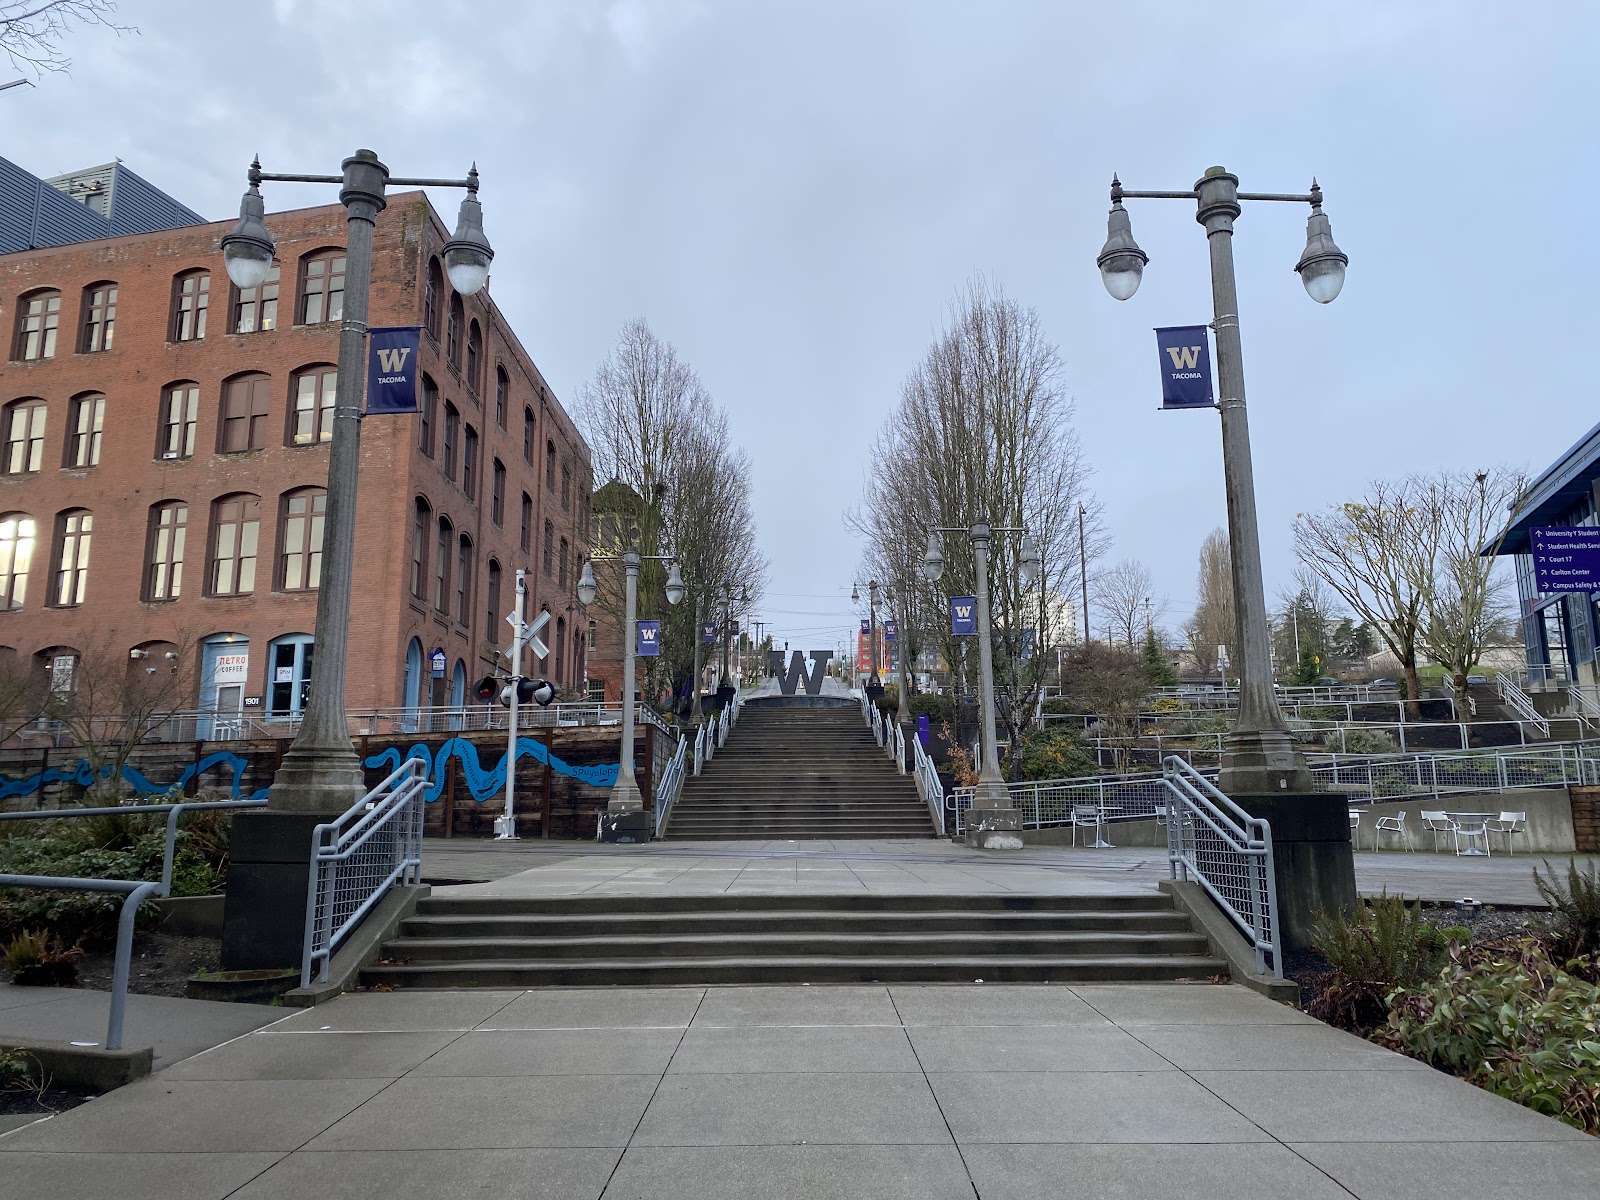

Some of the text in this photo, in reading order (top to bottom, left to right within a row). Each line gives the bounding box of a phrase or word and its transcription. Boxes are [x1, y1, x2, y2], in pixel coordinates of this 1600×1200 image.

[377, 348, 411, 373] W
[1166, 346, 1202, 370] W
[378, 376, 406, 384] TACOMA
[955, 606, 971, 618] W
[641, 629, 656, 640] W
[219, 656, 246, 665] METRO
[768, 650, 833, 695] W
[245, 697, 259, 705] 1901
